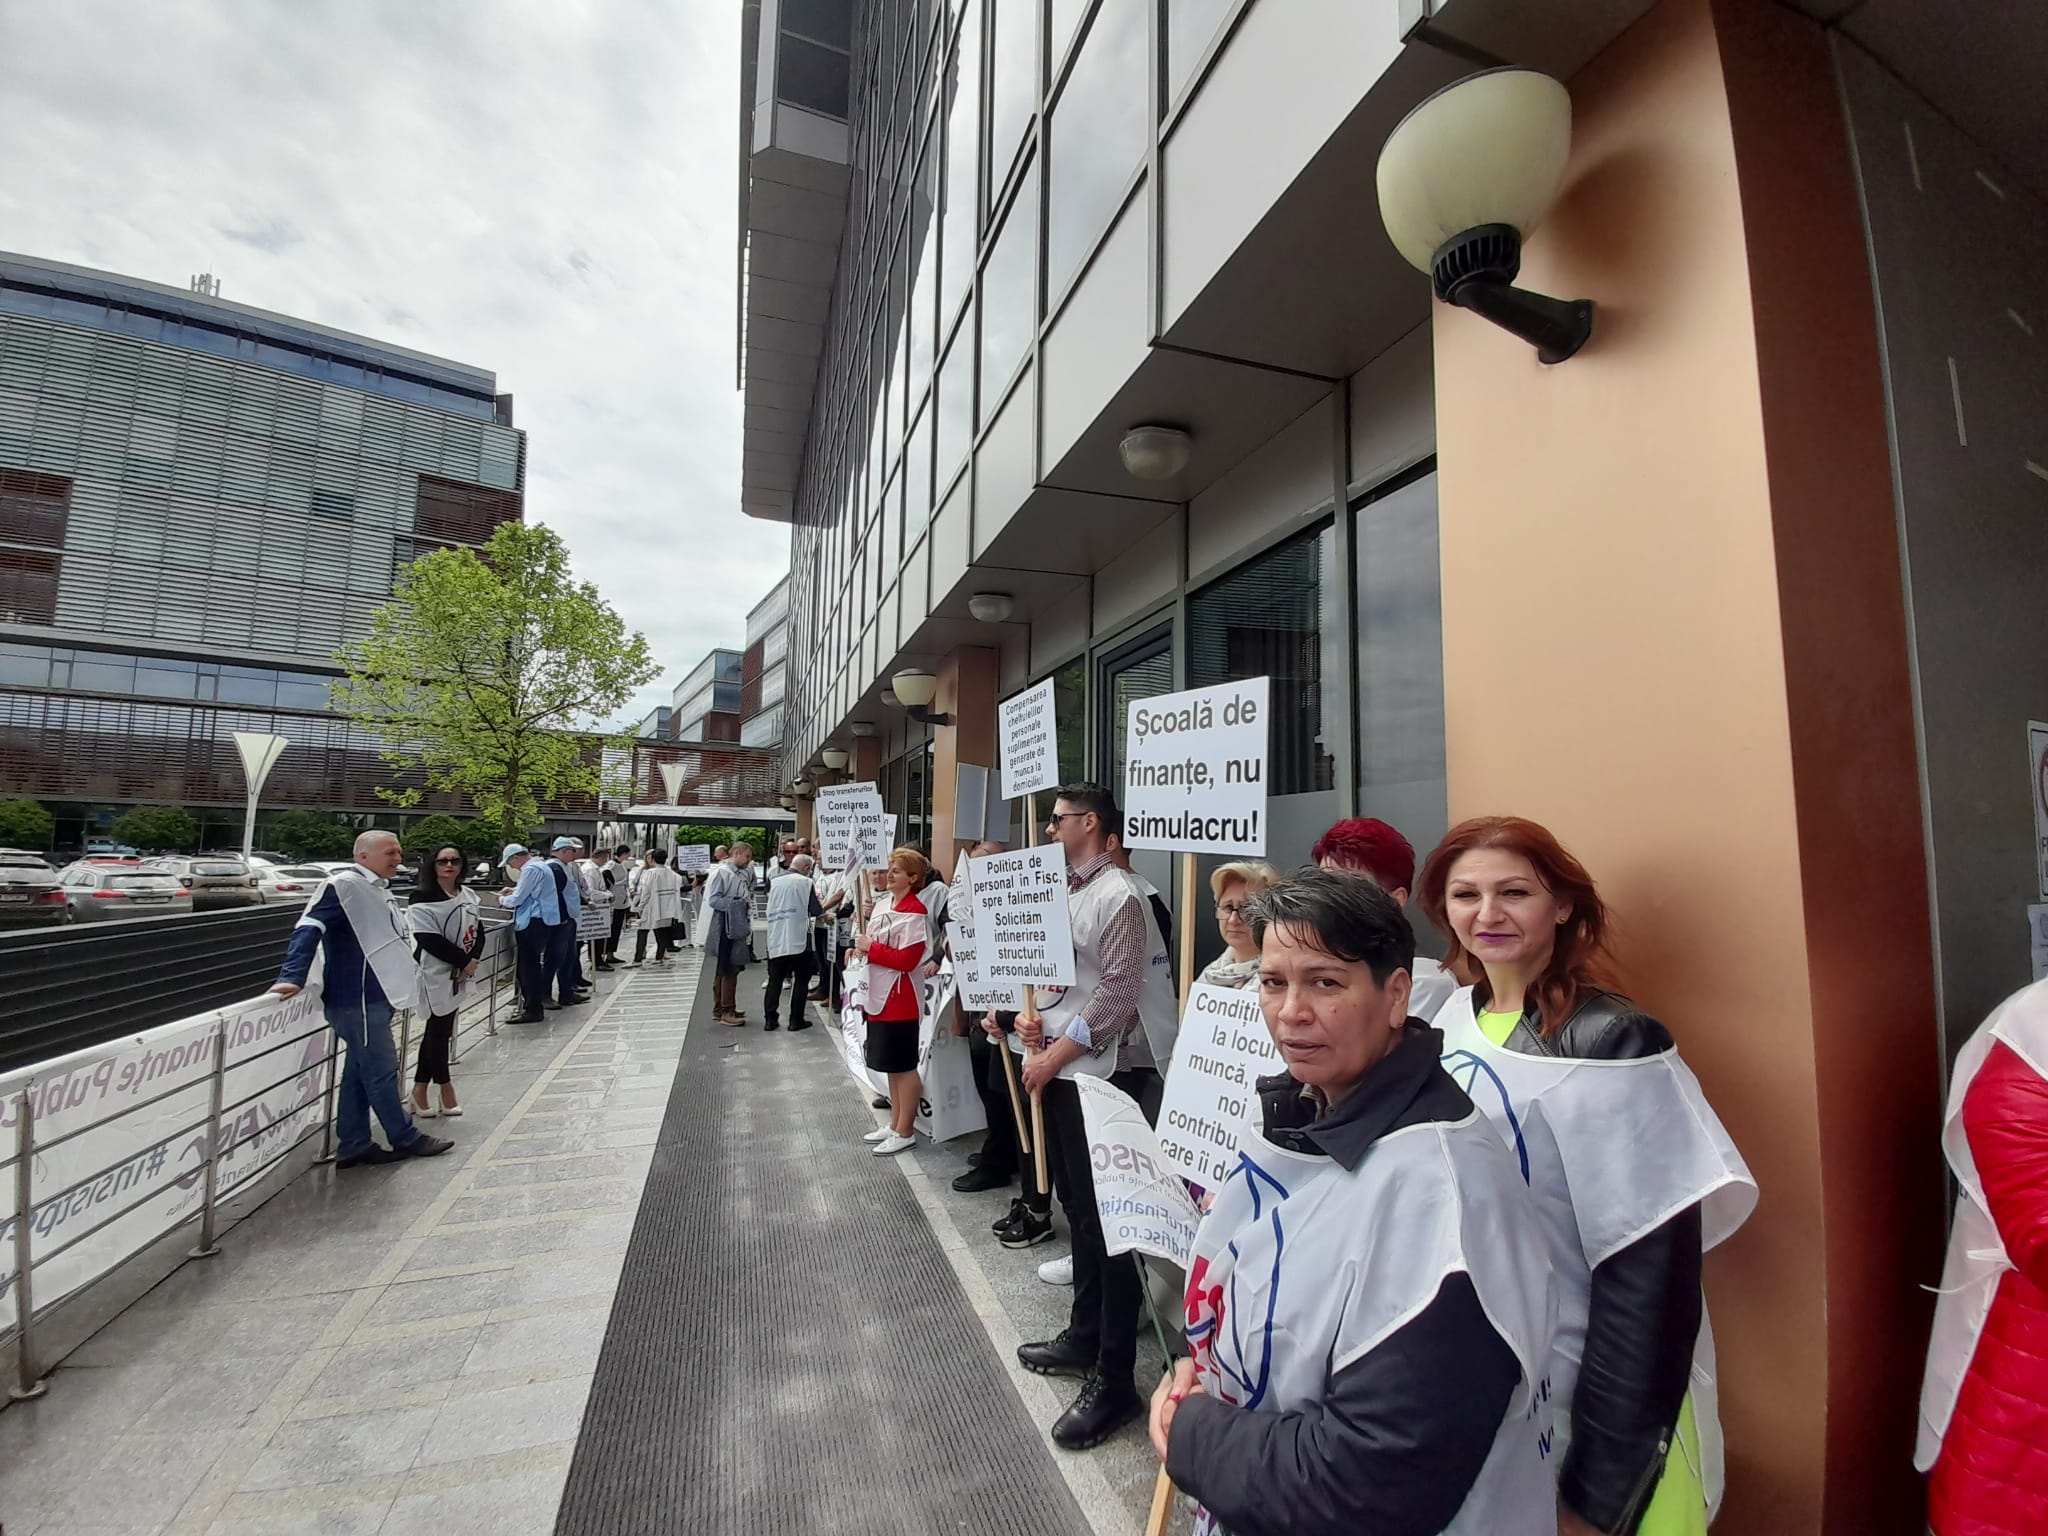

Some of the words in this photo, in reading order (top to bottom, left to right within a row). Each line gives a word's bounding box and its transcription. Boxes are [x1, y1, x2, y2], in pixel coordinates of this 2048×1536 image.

[1006, 688, 1047, 716] Compensarea
[1011, 719, 1041, 742] personale
[1135, 698, 1213, 746] Școală
[1223, 693, 1257, 726] de
[1007, 731, 1047, 755] suplimentare
[1009, 749, 1036, 769] generate
[1036, 745, 1045, 757] de
[1035, 761, 1042, 771] la
[1128, 755, 1214, 796] finanțe,
[1226, 758, 1261, 783] nu
[828, 801, 869, 811] Corelarea
[820, 814, 846, 827] fișelor
[861, 813, 881, 824] post
[1127, 809, 1258, 843] simulacru!
[825, 830, 836, 838] cu
[987, 859, 1023, 875] Politica
[1029, 854, 1042, 869] de
[974, 876, 1014, 896] personal
[1019, 873, 1029, 888] în
[1035, 870, 1063, 886] Fisc,
[982, 895, 1003, 911] spre
[1007, 888, 1054, 906] faliment!
[995, 910, 1042, 926] Solicităm
[994, 928, 1046, 943] intinerirea
[998, 945, 1045, 960] structurii
[990, 962, 1058, 978] personalului!
[968, 990, 1015, 1006] specifice!
[1212, 1024, 1226, 1046] la
[1188, 1053, 1249, 1089] muncă,
[1217, 1095, 1248, 1119] noi
[1168, 1109, 1238, 1152] contribu
[1160, 1138, 1194, 1167] care
[1197, 1150, 1210, 1175] îi
